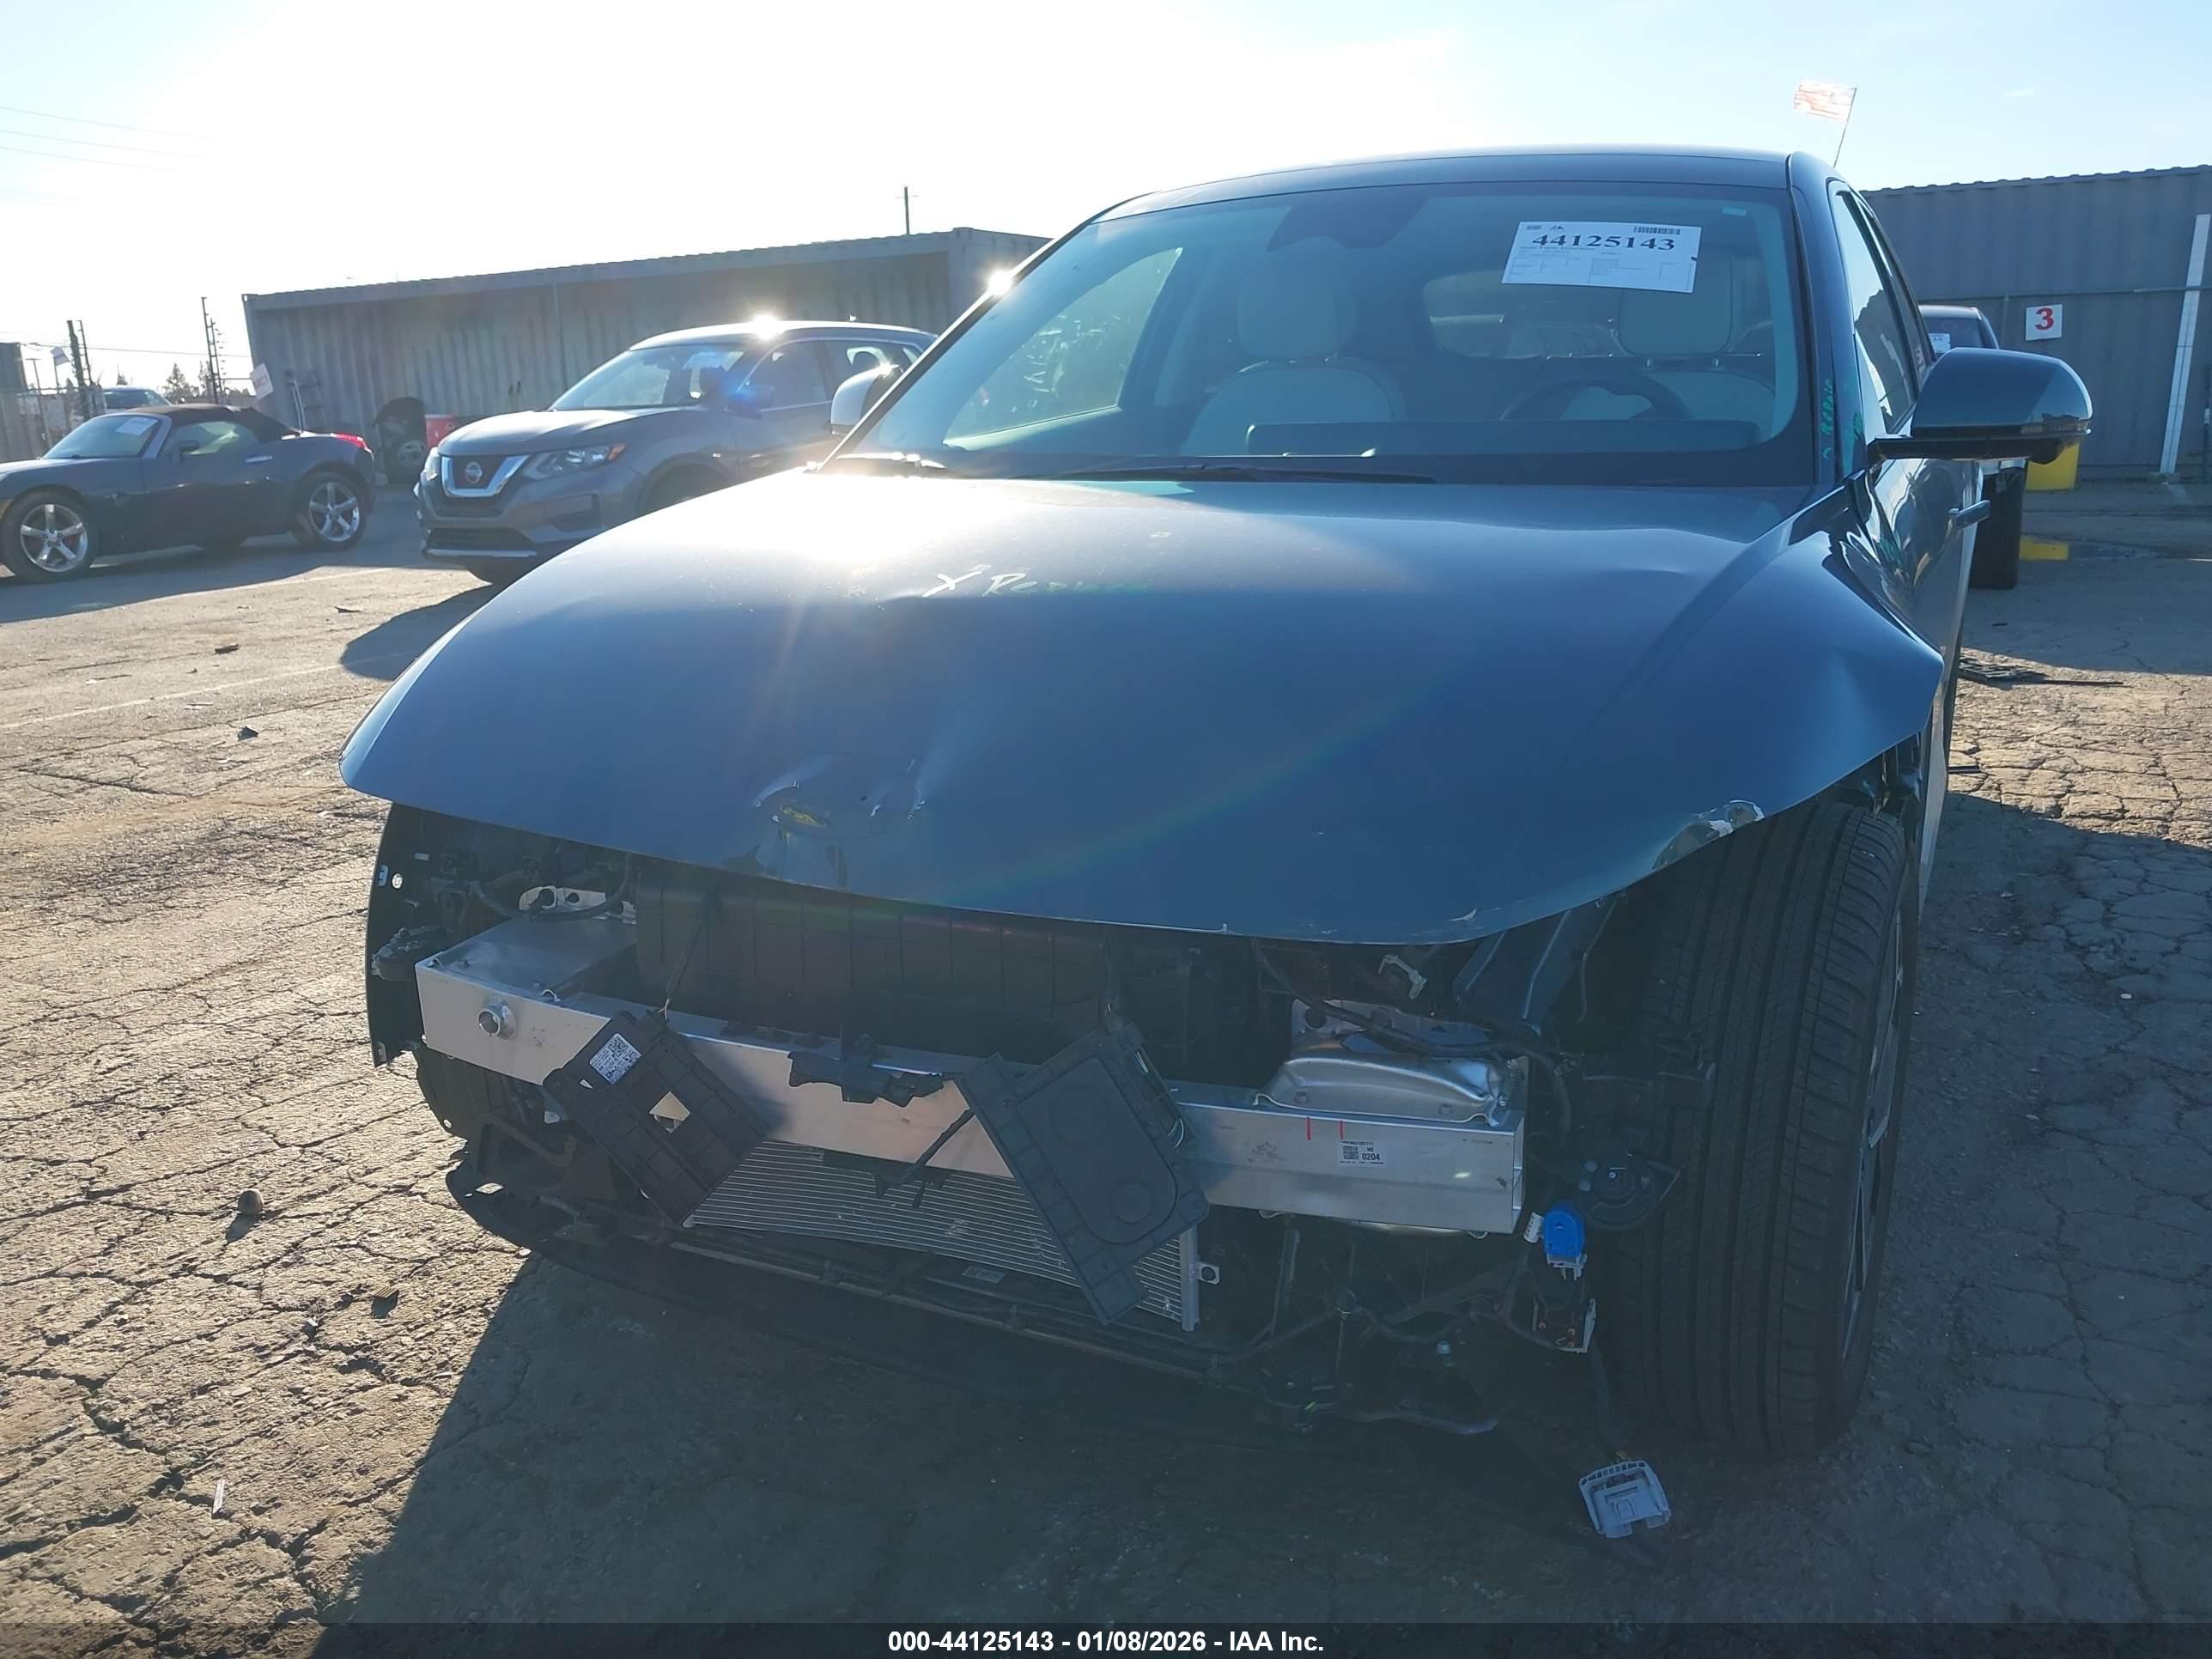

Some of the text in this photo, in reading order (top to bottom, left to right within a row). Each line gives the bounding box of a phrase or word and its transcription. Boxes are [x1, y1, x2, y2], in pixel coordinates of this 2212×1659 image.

[1532, 234, 1675, 251] 44125143
[2035, 307, 2055, 331] 3
[1362, 1152, 1381, 1161] 0204
